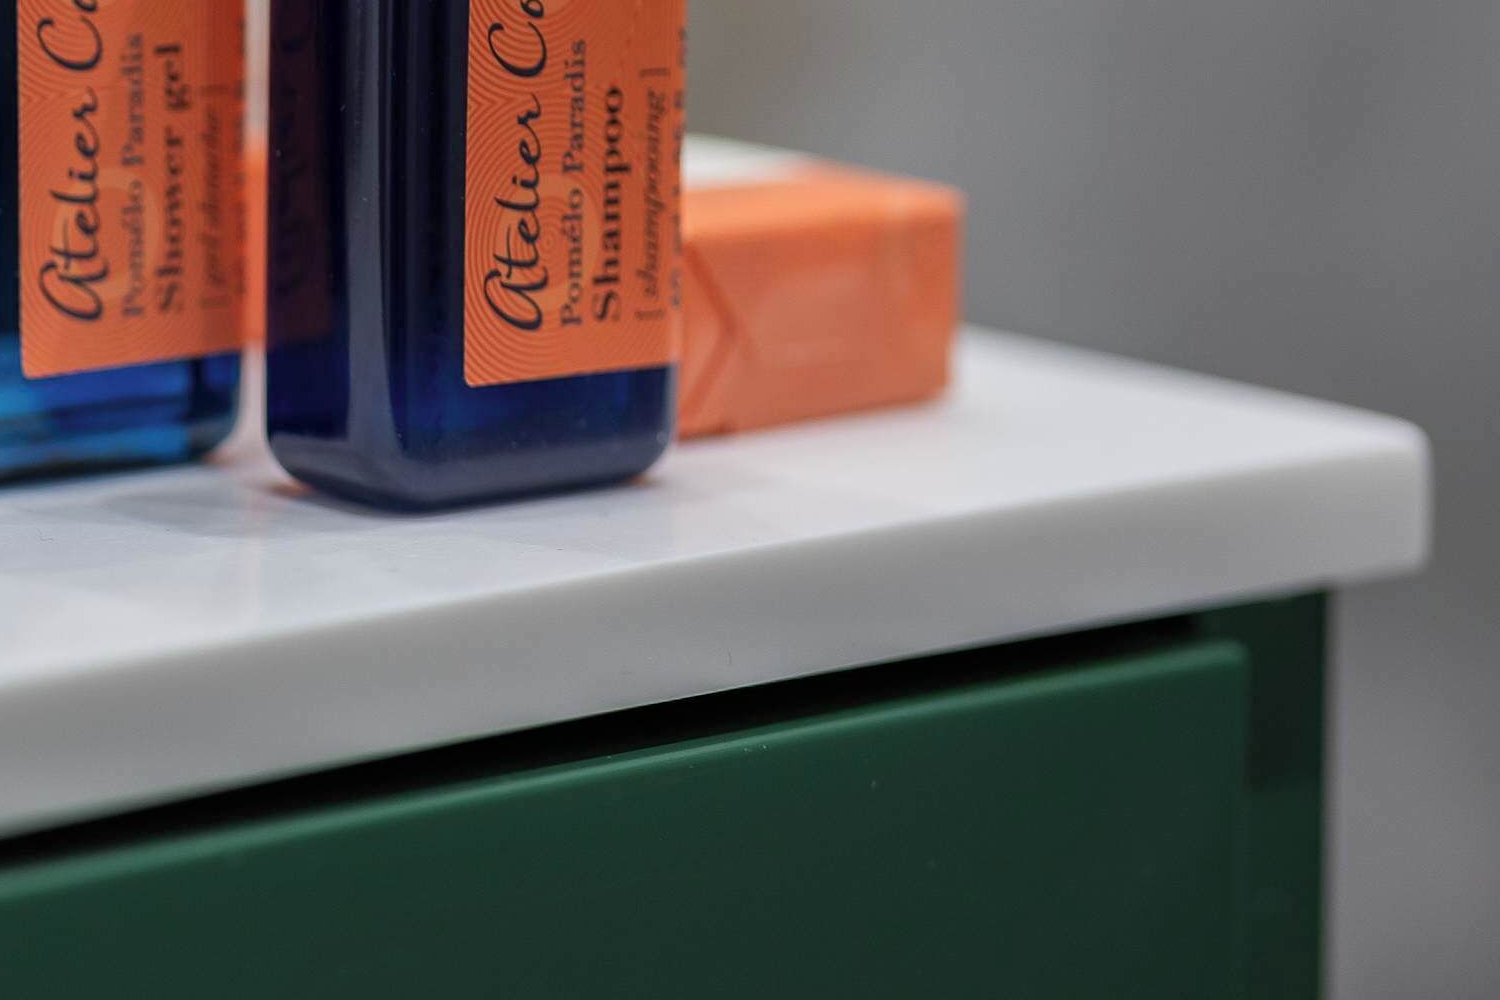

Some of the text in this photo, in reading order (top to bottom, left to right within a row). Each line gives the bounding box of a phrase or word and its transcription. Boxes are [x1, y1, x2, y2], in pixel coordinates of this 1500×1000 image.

[38, 86, 109, 322] Atelier
[121, 33, 145, 165] Paradis
[154, 42, 191, 315] Shower gel
[483, 93, 549, 331] Atelier
[560, 39, 587, 328] Pomélo Paradis
[593, 86, 632, 321] Shampoo
